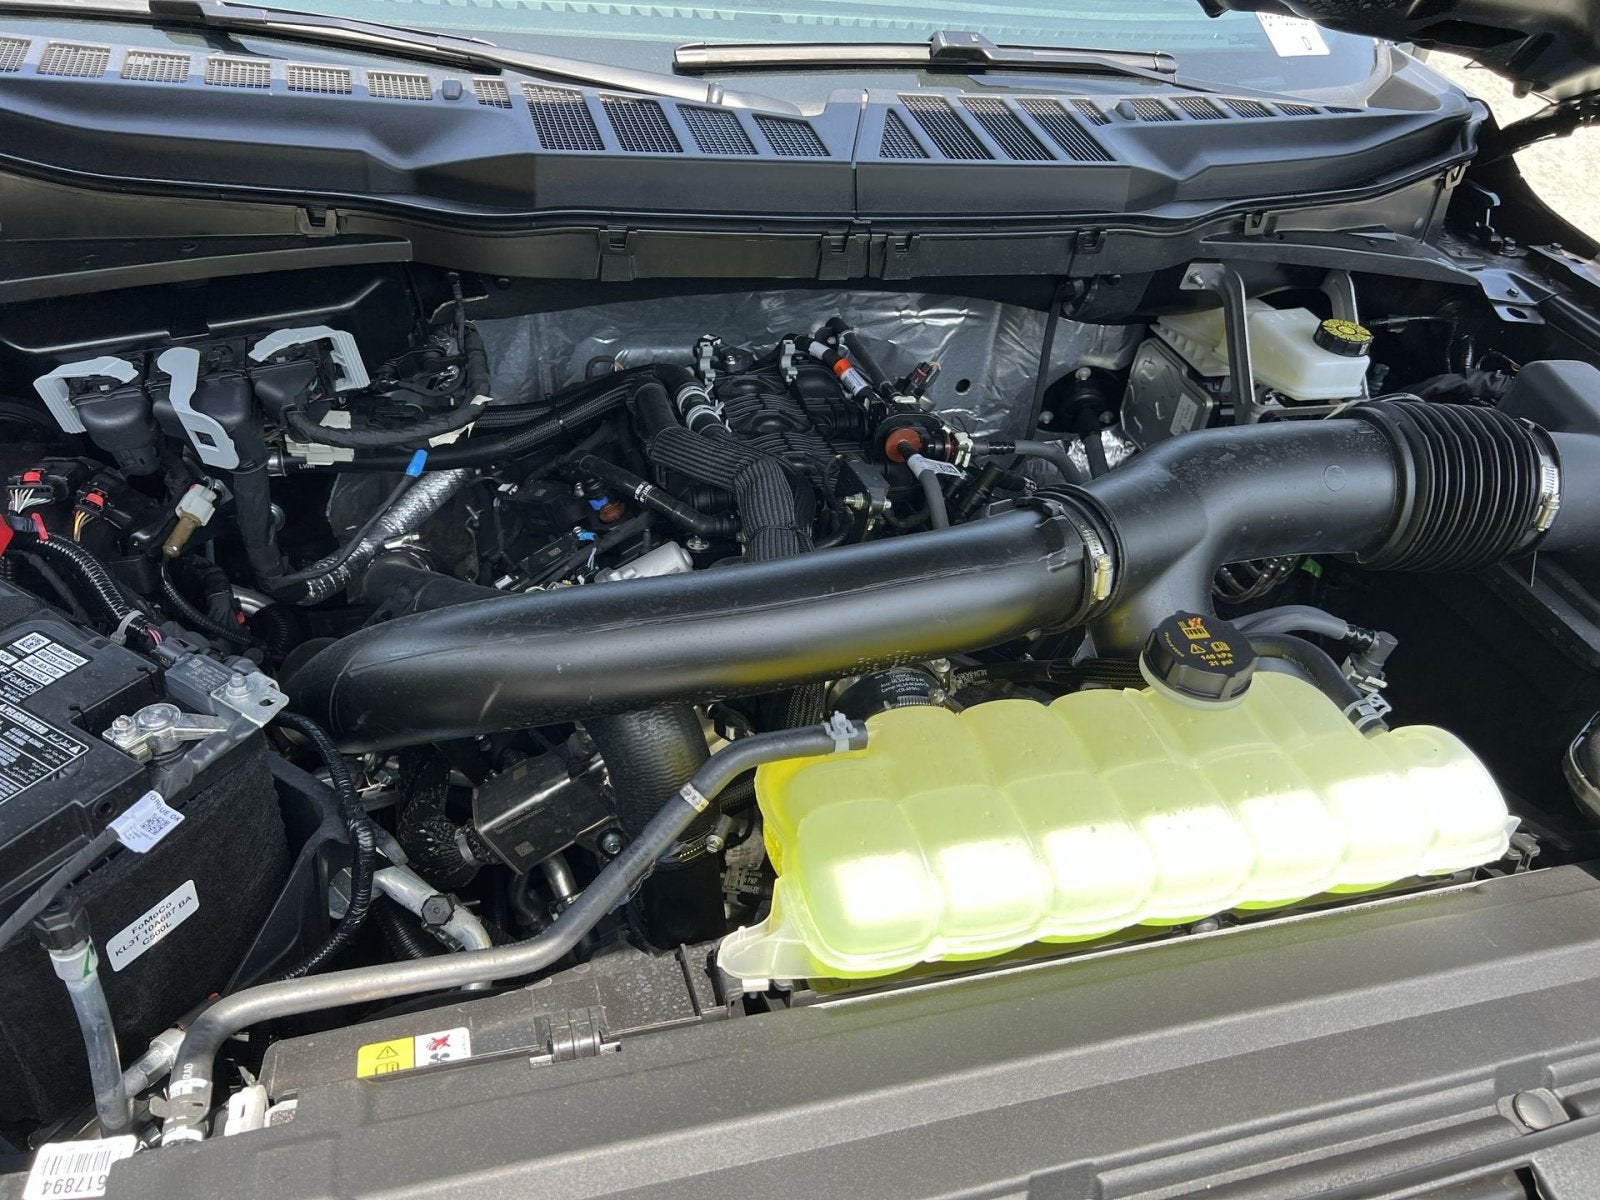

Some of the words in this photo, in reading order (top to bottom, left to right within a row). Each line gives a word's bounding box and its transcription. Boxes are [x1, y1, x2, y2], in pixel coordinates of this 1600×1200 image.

[8, 673, 38, 694] FoMoCo
[147, 792, 169, 816] TORQUE
[170, 811, 182, 823] OK
[115, 936, 141, 957] KL3T
[143, 907, 176, 935] 10A687
[178, 895, 192, 909] BA
[131, 901, 173, 934] FoMoCo
[142, 922, 173, 946] C500L
[41, 1174, 108, 1196] 617894
